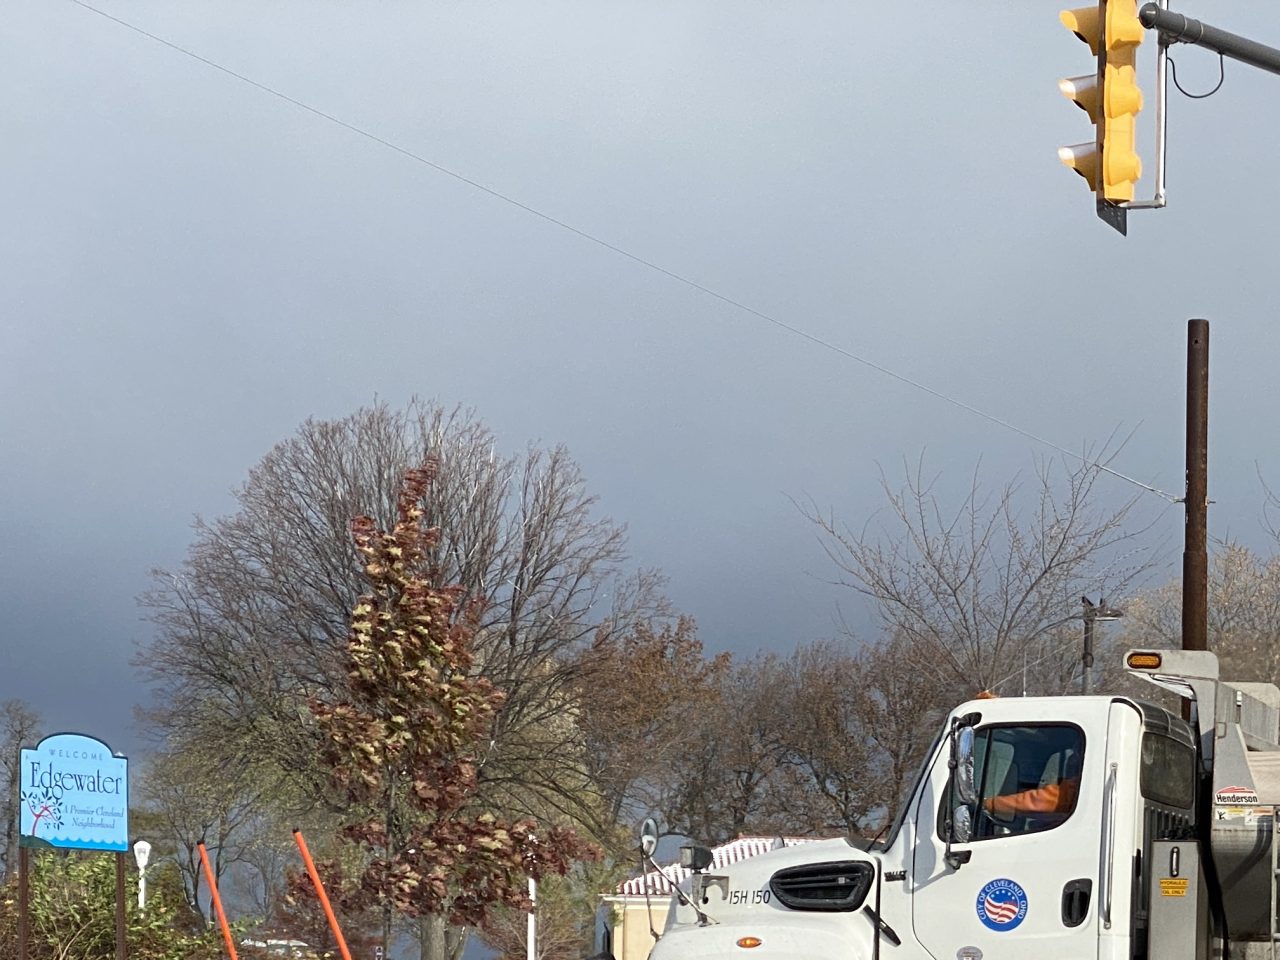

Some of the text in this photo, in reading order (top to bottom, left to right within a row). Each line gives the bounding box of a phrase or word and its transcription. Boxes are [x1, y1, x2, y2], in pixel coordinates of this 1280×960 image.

[48, 748, 103, 761] WELCOME
[30, 761, 122, 801] Edgewater
[1216, 794, 1258, 803] Henderson
[729, 889, 771, 904] 15H 150
[977, 880, 1027, 920] CITY OF CLEVELAND OHIO
